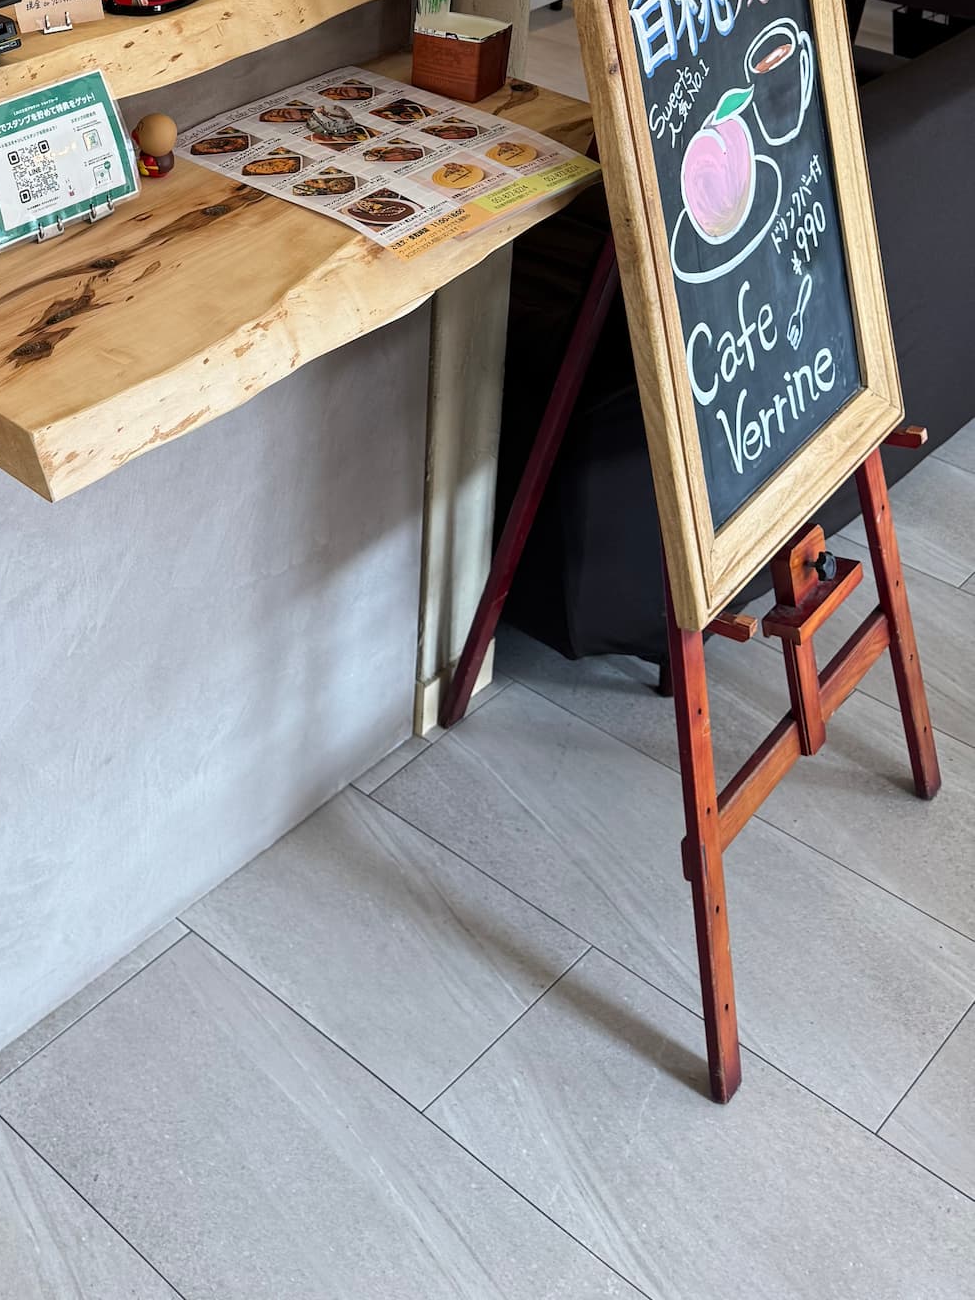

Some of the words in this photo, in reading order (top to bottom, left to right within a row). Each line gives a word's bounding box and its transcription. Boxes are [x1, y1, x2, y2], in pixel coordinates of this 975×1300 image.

[648, 66, 693, 140] Sweets
[27, 166, 43, 177] LINE
[685, 279, 778, 407] Cafe
[715, 346, 837, 476] Verrine
